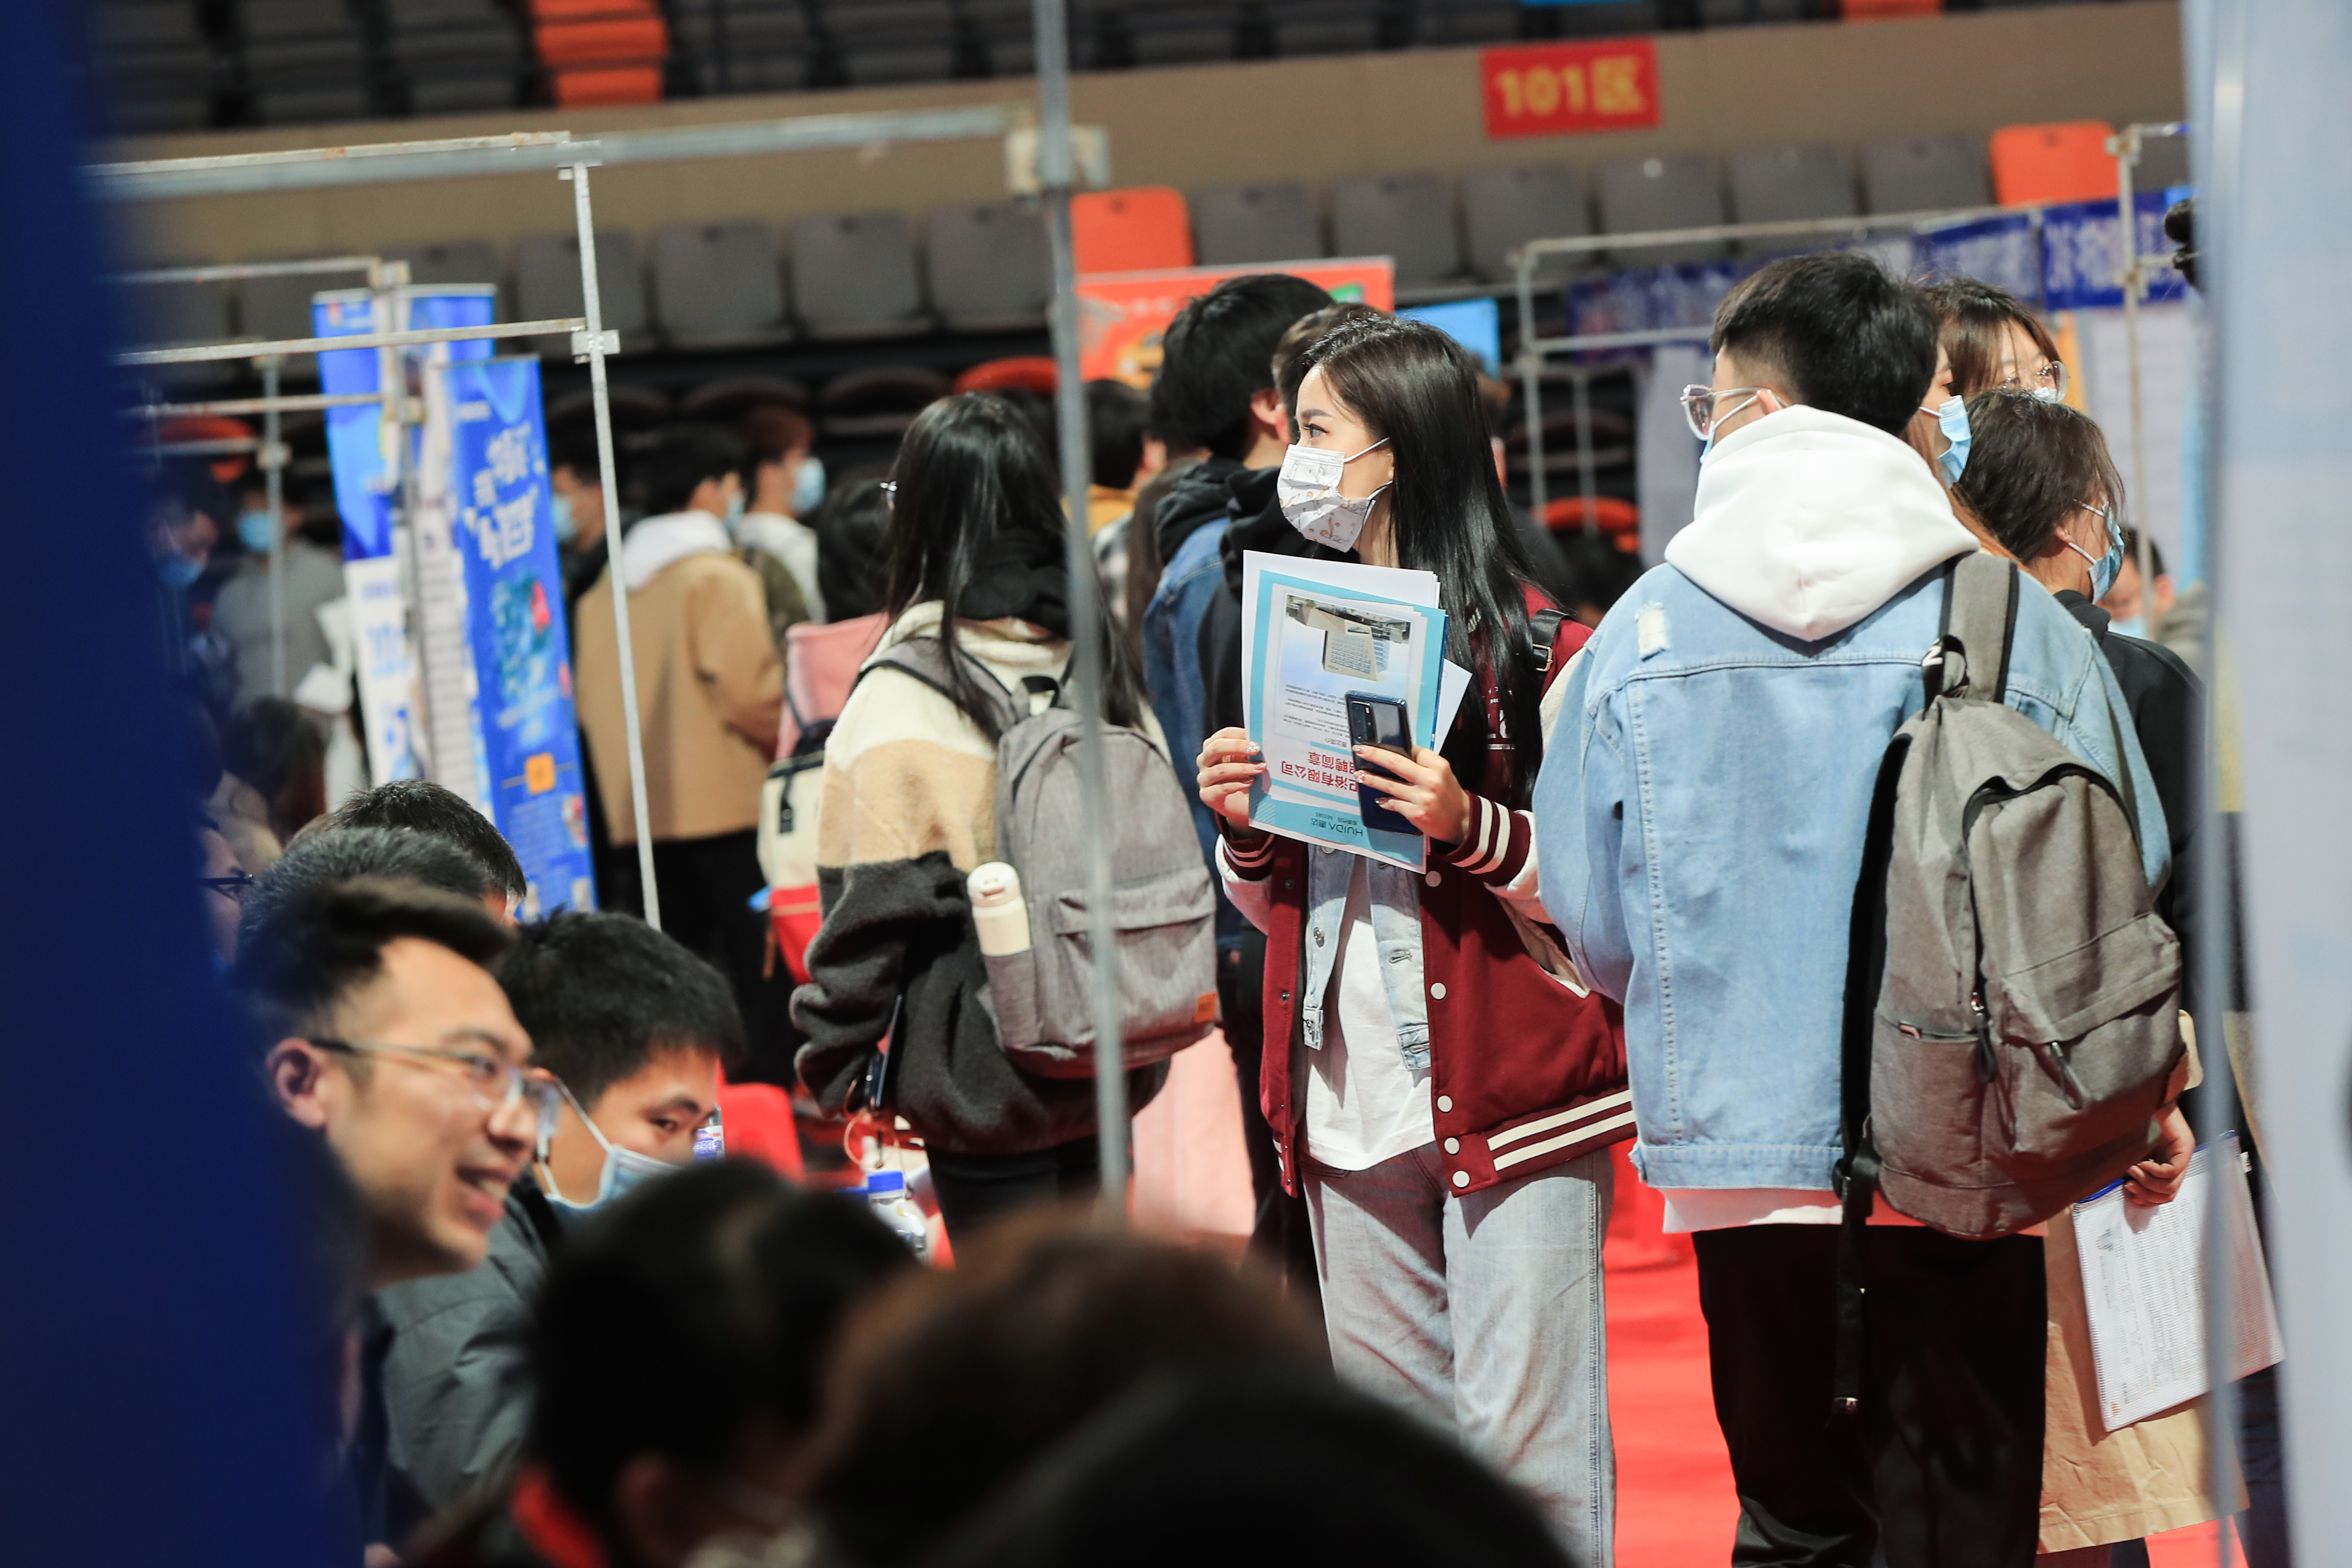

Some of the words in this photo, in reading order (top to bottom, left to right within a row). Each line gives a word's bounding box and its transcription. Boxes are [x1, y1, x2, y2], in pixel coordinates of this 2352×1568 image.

[1492, 54, 1647, 118] 101区
[1310, 817, 1326, 828] 惠达
[1328, 822, 1363, 837] HUIDA
